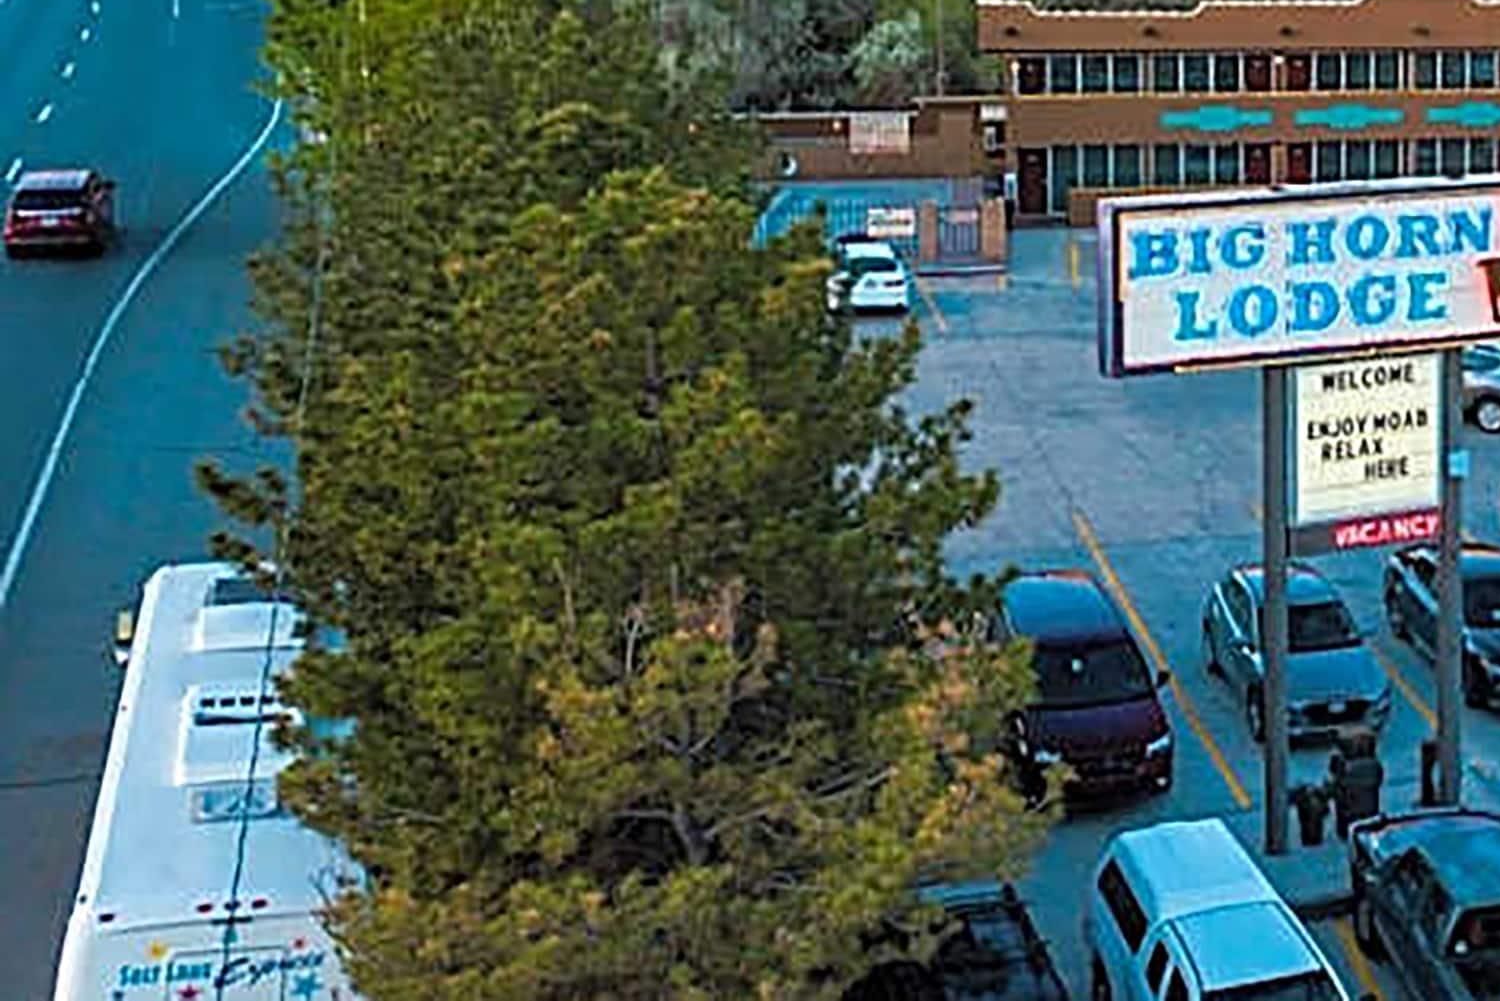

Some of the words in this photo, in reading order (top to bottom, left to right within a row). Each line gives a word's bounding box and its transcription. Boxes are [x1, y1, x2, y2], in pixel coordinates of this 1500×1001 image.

[1128, 221, 1266, 280] BIG
[1287, 206, 1493, 265] HORN
[1174, 271, 1449, 341] LODGE
[1322, 363, 1415, 392] WELCOME
[1307, 412, 1368, 440] ENJOY
[1373, 408, 1428, 432] MOAB
[1321, 437, 1383, 462] RELAX
[1364, 454, 1409, 481] HERE
[1335, 513, 1440, 547] VACANCY
